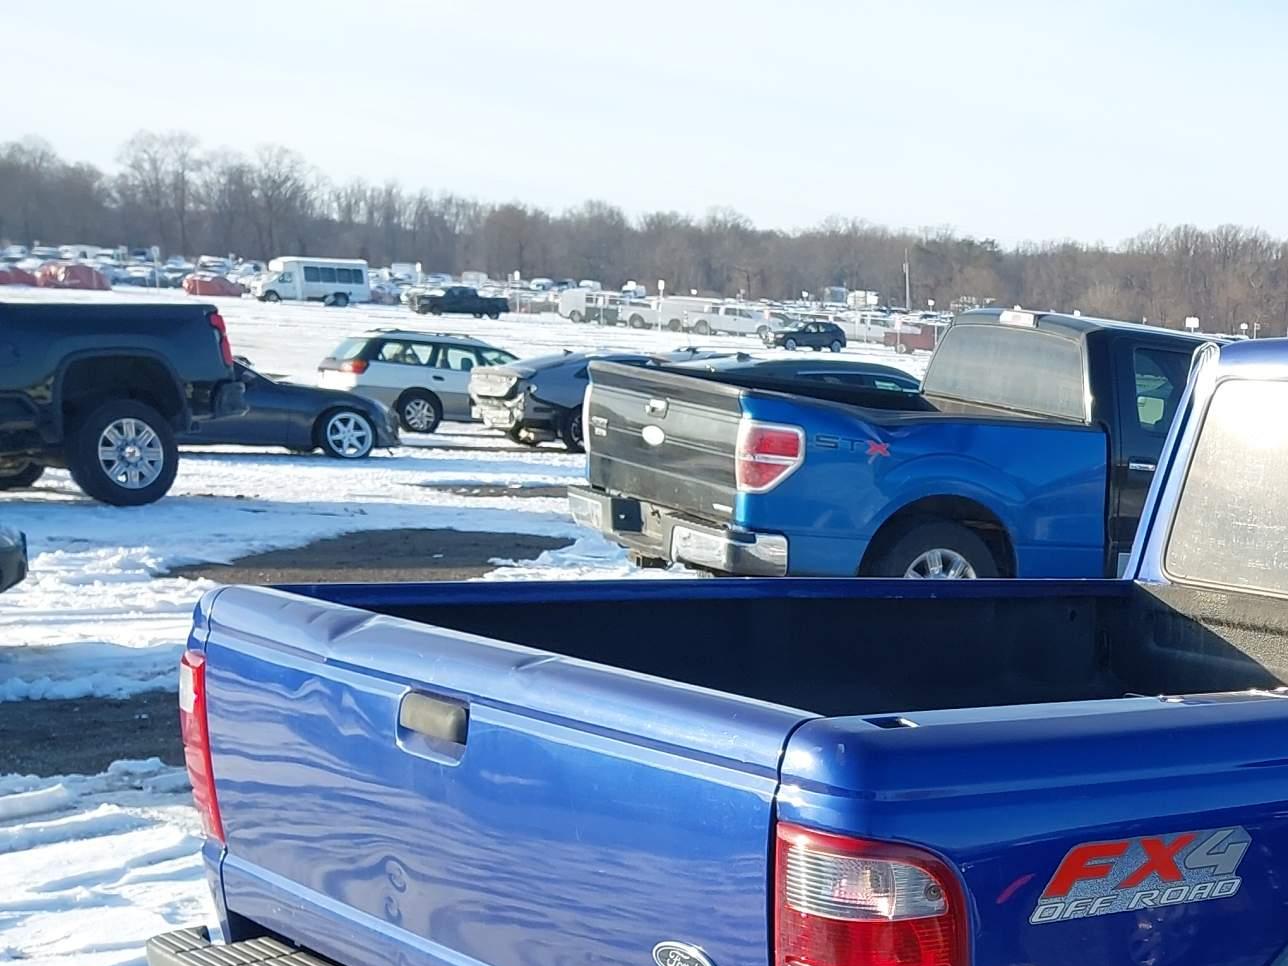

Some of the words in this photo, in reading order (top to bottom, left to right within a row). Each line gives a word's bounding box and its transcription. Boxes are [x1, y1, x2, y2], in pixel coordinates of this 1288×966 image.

[815, 433, 891, 464] STX
[1040, 828, 1250, 897] FX4
[1031, 895, 1119, 923] OFF
[1128, 877, 1241, 909] ROAD
